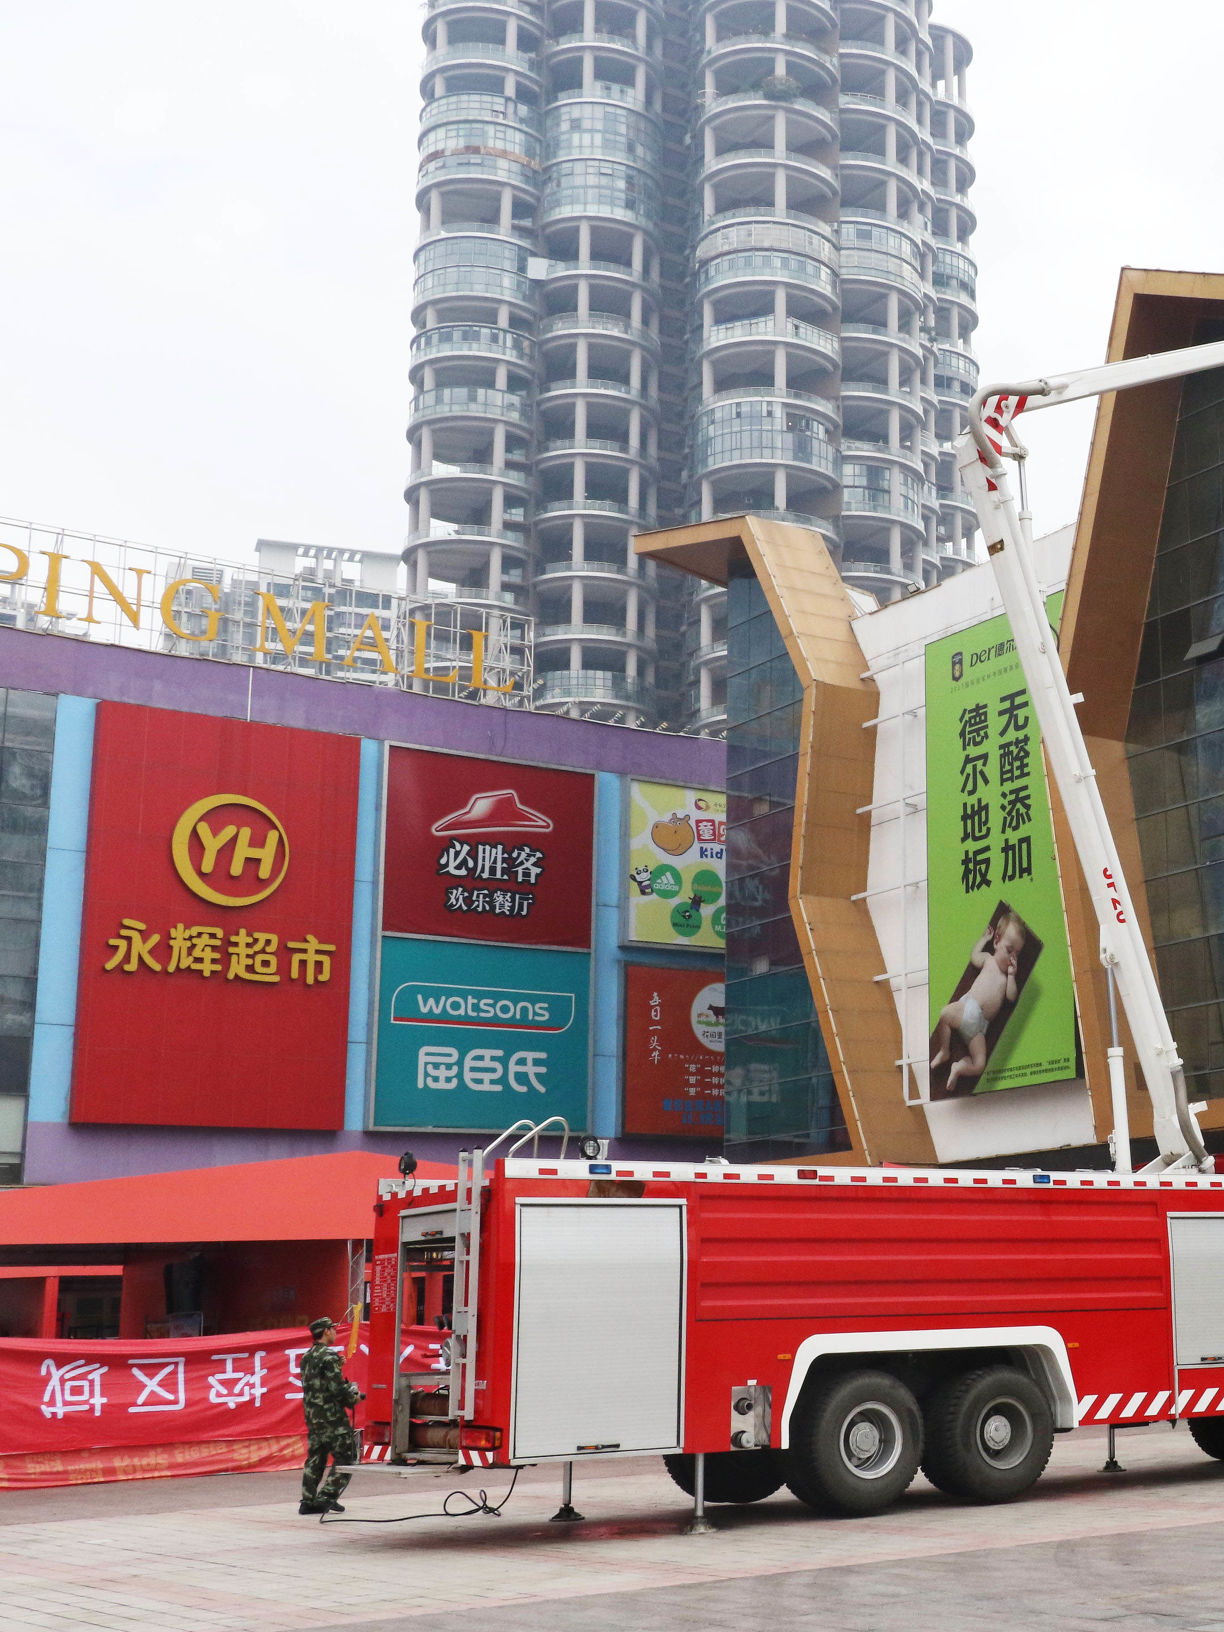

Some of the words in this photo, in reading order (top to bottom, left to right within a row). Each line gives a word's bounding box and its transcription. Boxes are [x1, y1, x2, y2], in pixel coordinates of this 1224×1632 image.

[252, 590, 515, 693] MALL
[958, 702, 992, 894] 德尔地板
[997, 687, 1033, 884] 无醛添加
[196, 820, 280, 880] YH
[439, 841, 544, 884] 必胜客
[447, 886, 534, 917] 欢乐餐厅
[104, 918, 337, 985] 永辉超市
[416, 993, 551, 1022] watsons
[649, 991, 663, 1065] 每日一头牛
[417, 1045, 548, 1094] 屈臣氏
